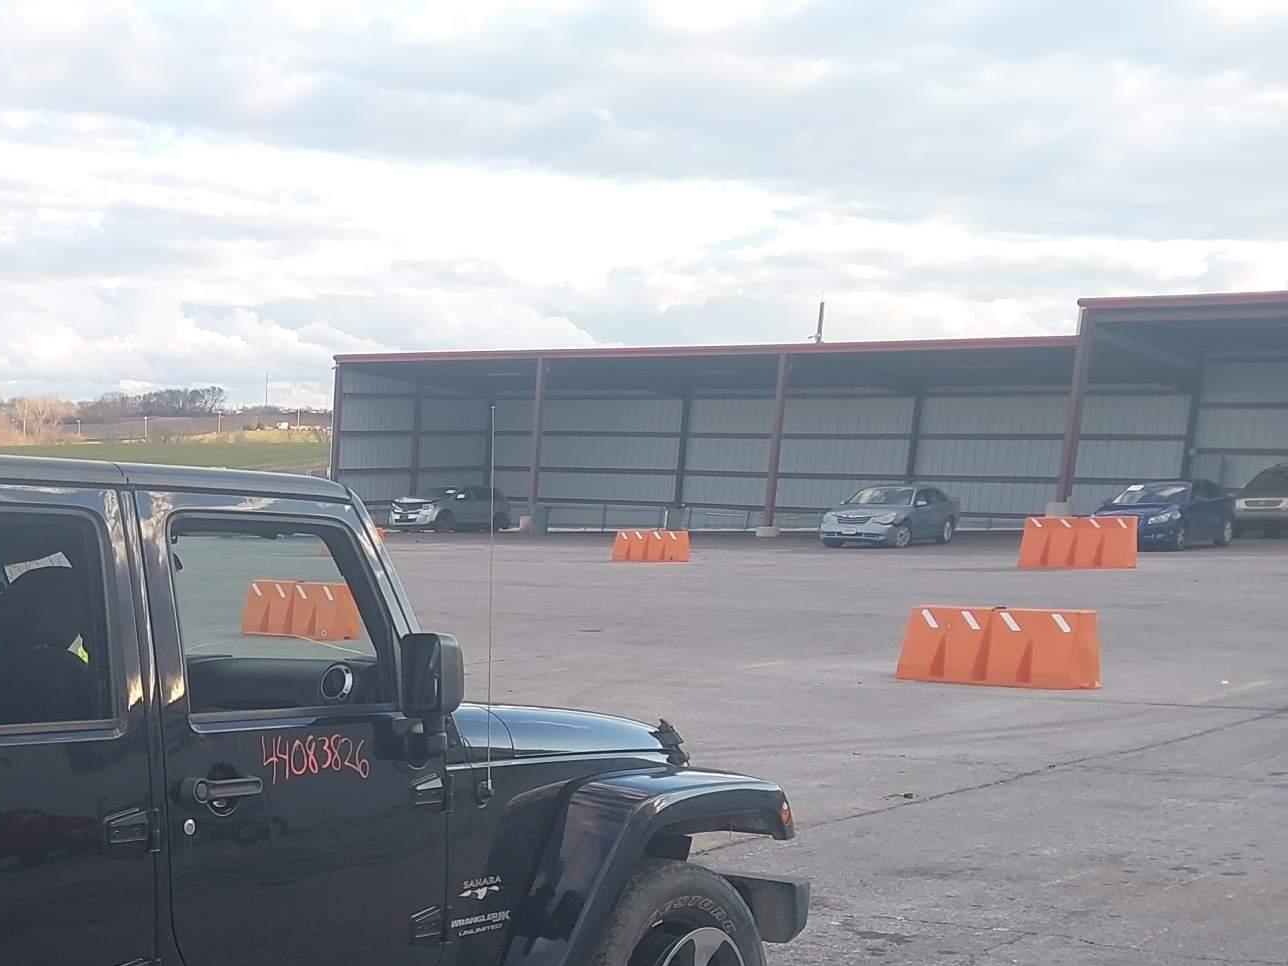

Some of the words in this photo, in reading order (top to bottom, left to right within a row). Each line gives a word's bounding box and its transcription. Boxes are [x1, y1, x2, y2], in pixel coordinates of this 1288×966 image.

[261, 733, 370, 785] 44083826
[463, 875, 502, 889] SAHARA
[458, 923, 502, 936] UNLIMITED
